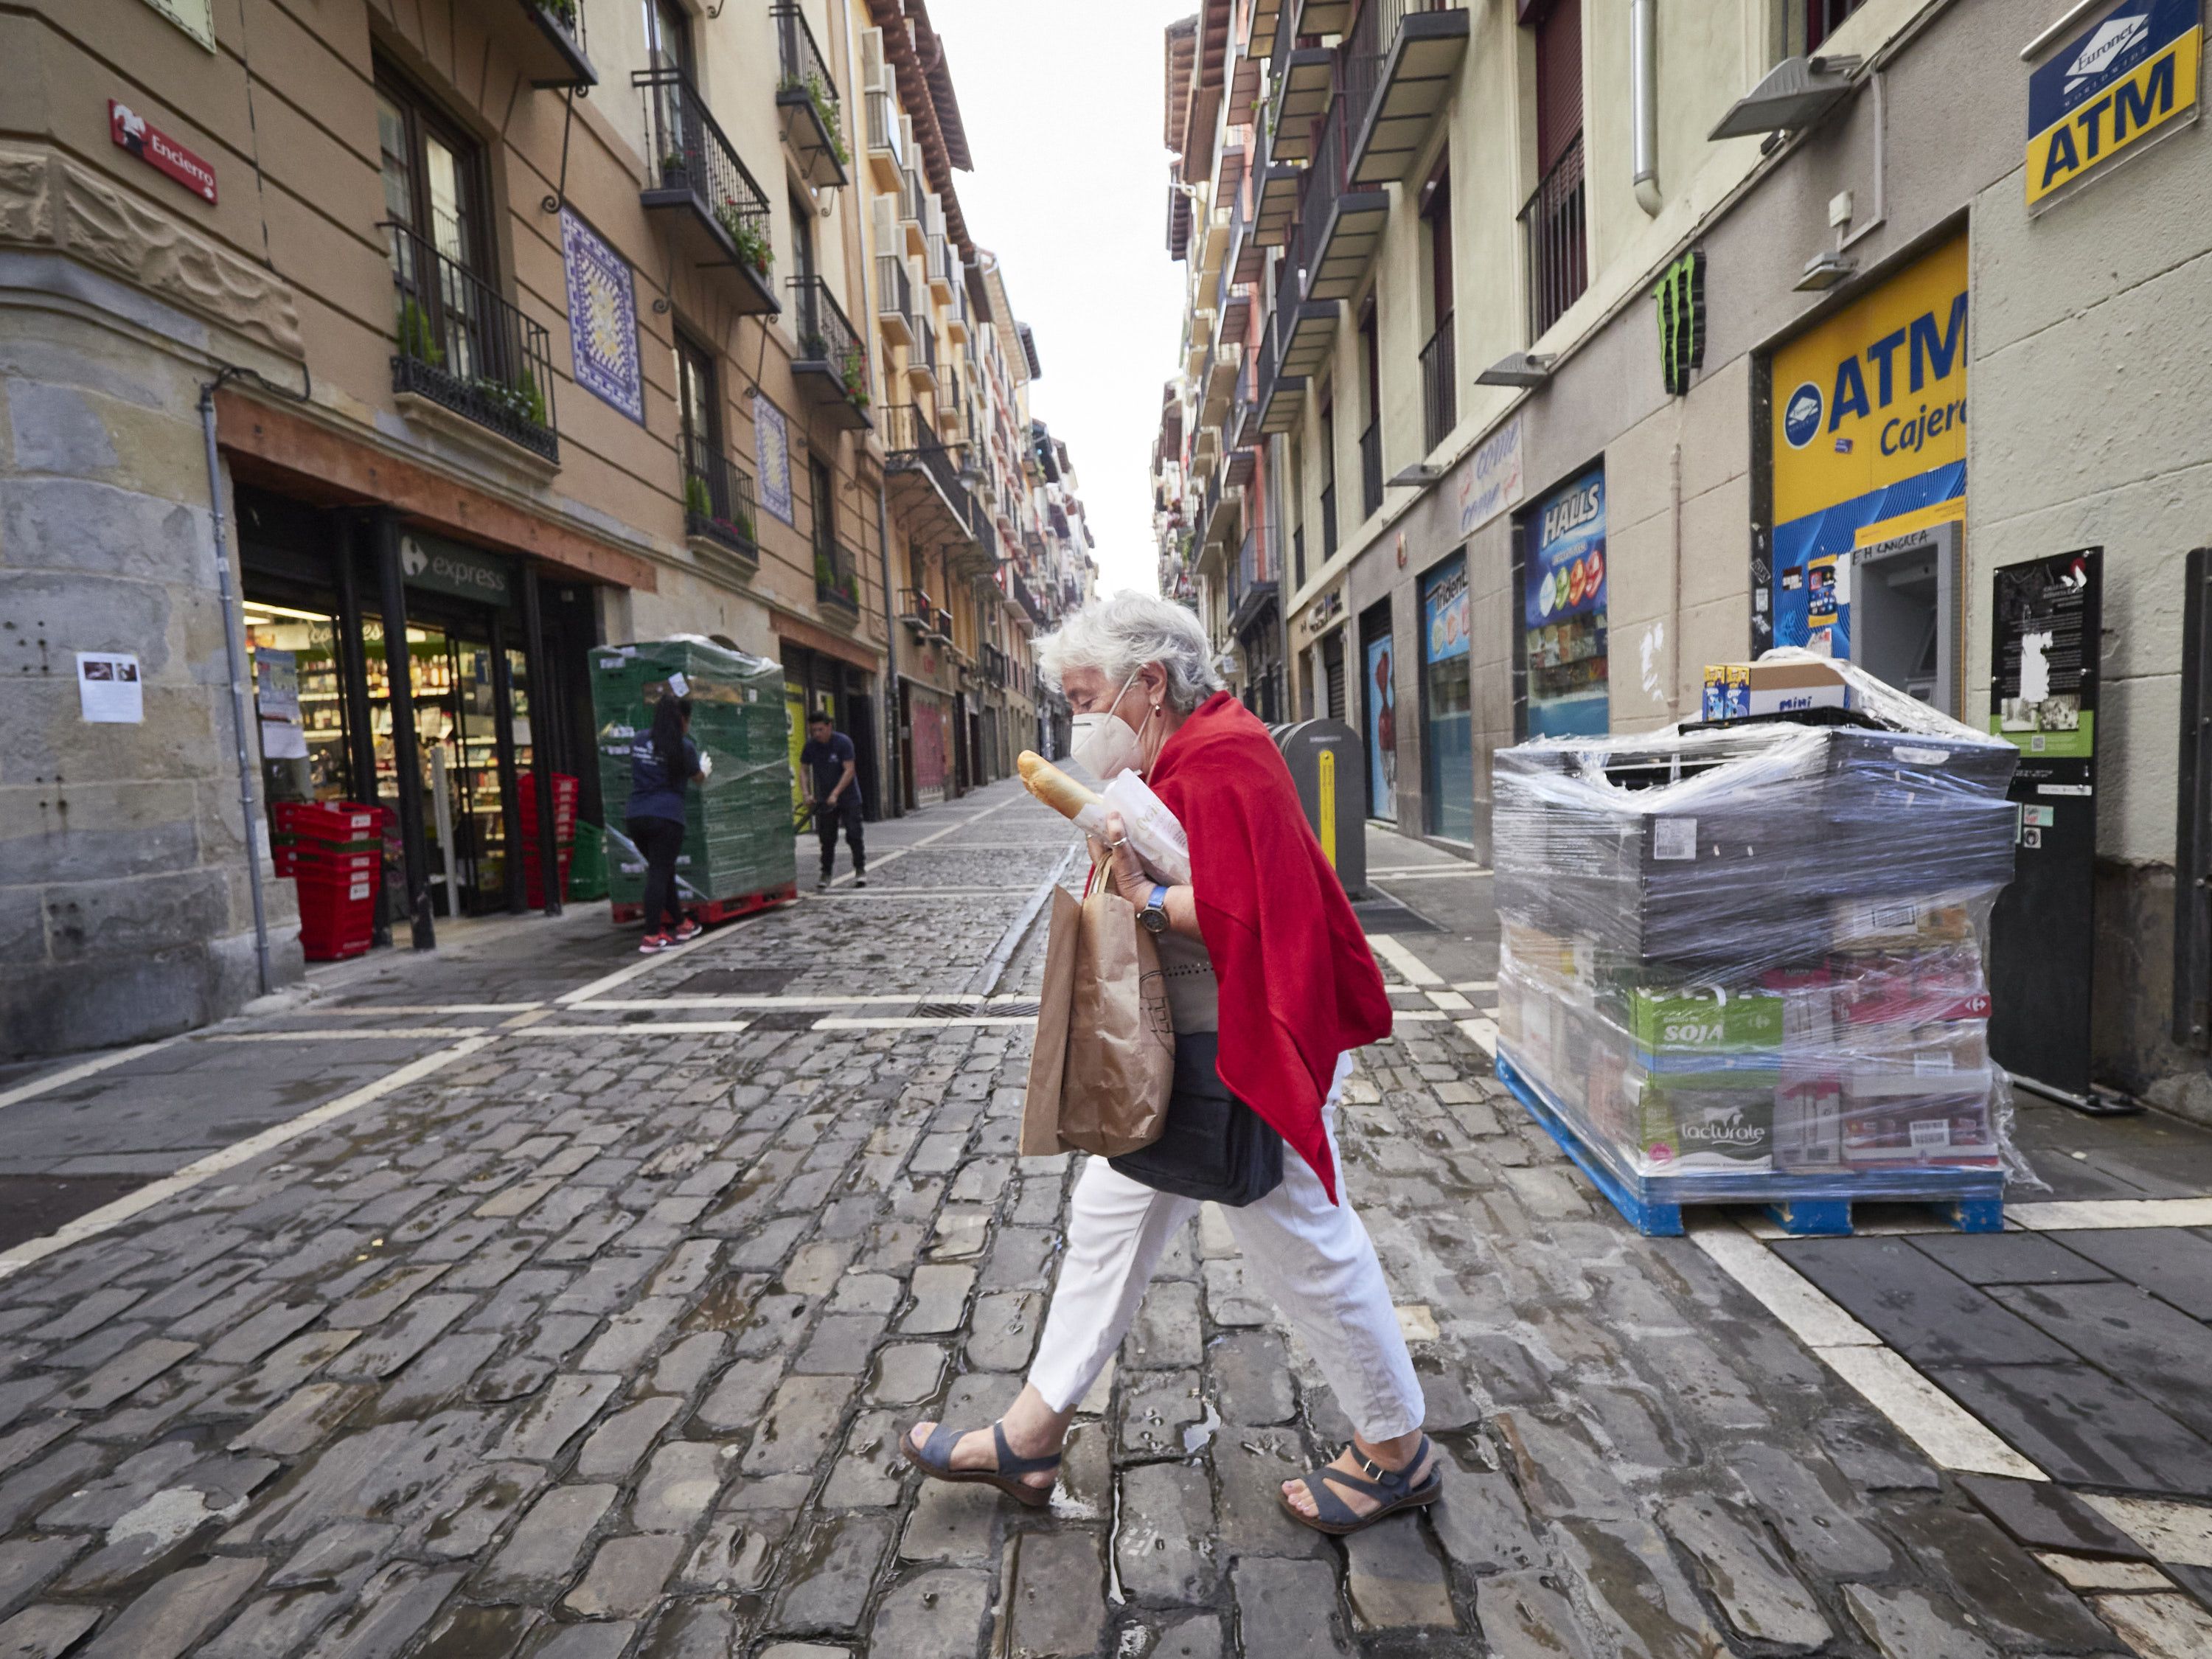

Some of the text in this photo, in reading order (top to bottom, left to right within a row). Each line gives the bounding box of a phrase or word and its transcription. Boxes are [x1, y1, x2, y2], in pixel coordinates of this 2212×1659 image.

[2077, 23, 2134, 72] Euronet
[2041, 51, 2176, 190] ATM
[152, 133, 214, 187] Encierro
[1827, 291, 1968, 434] ATM
[1542, 482, 1600, 549] HALLS
[432, 557, 505, 591] express
[1663, 1023, 1724, 1043] SOJA
